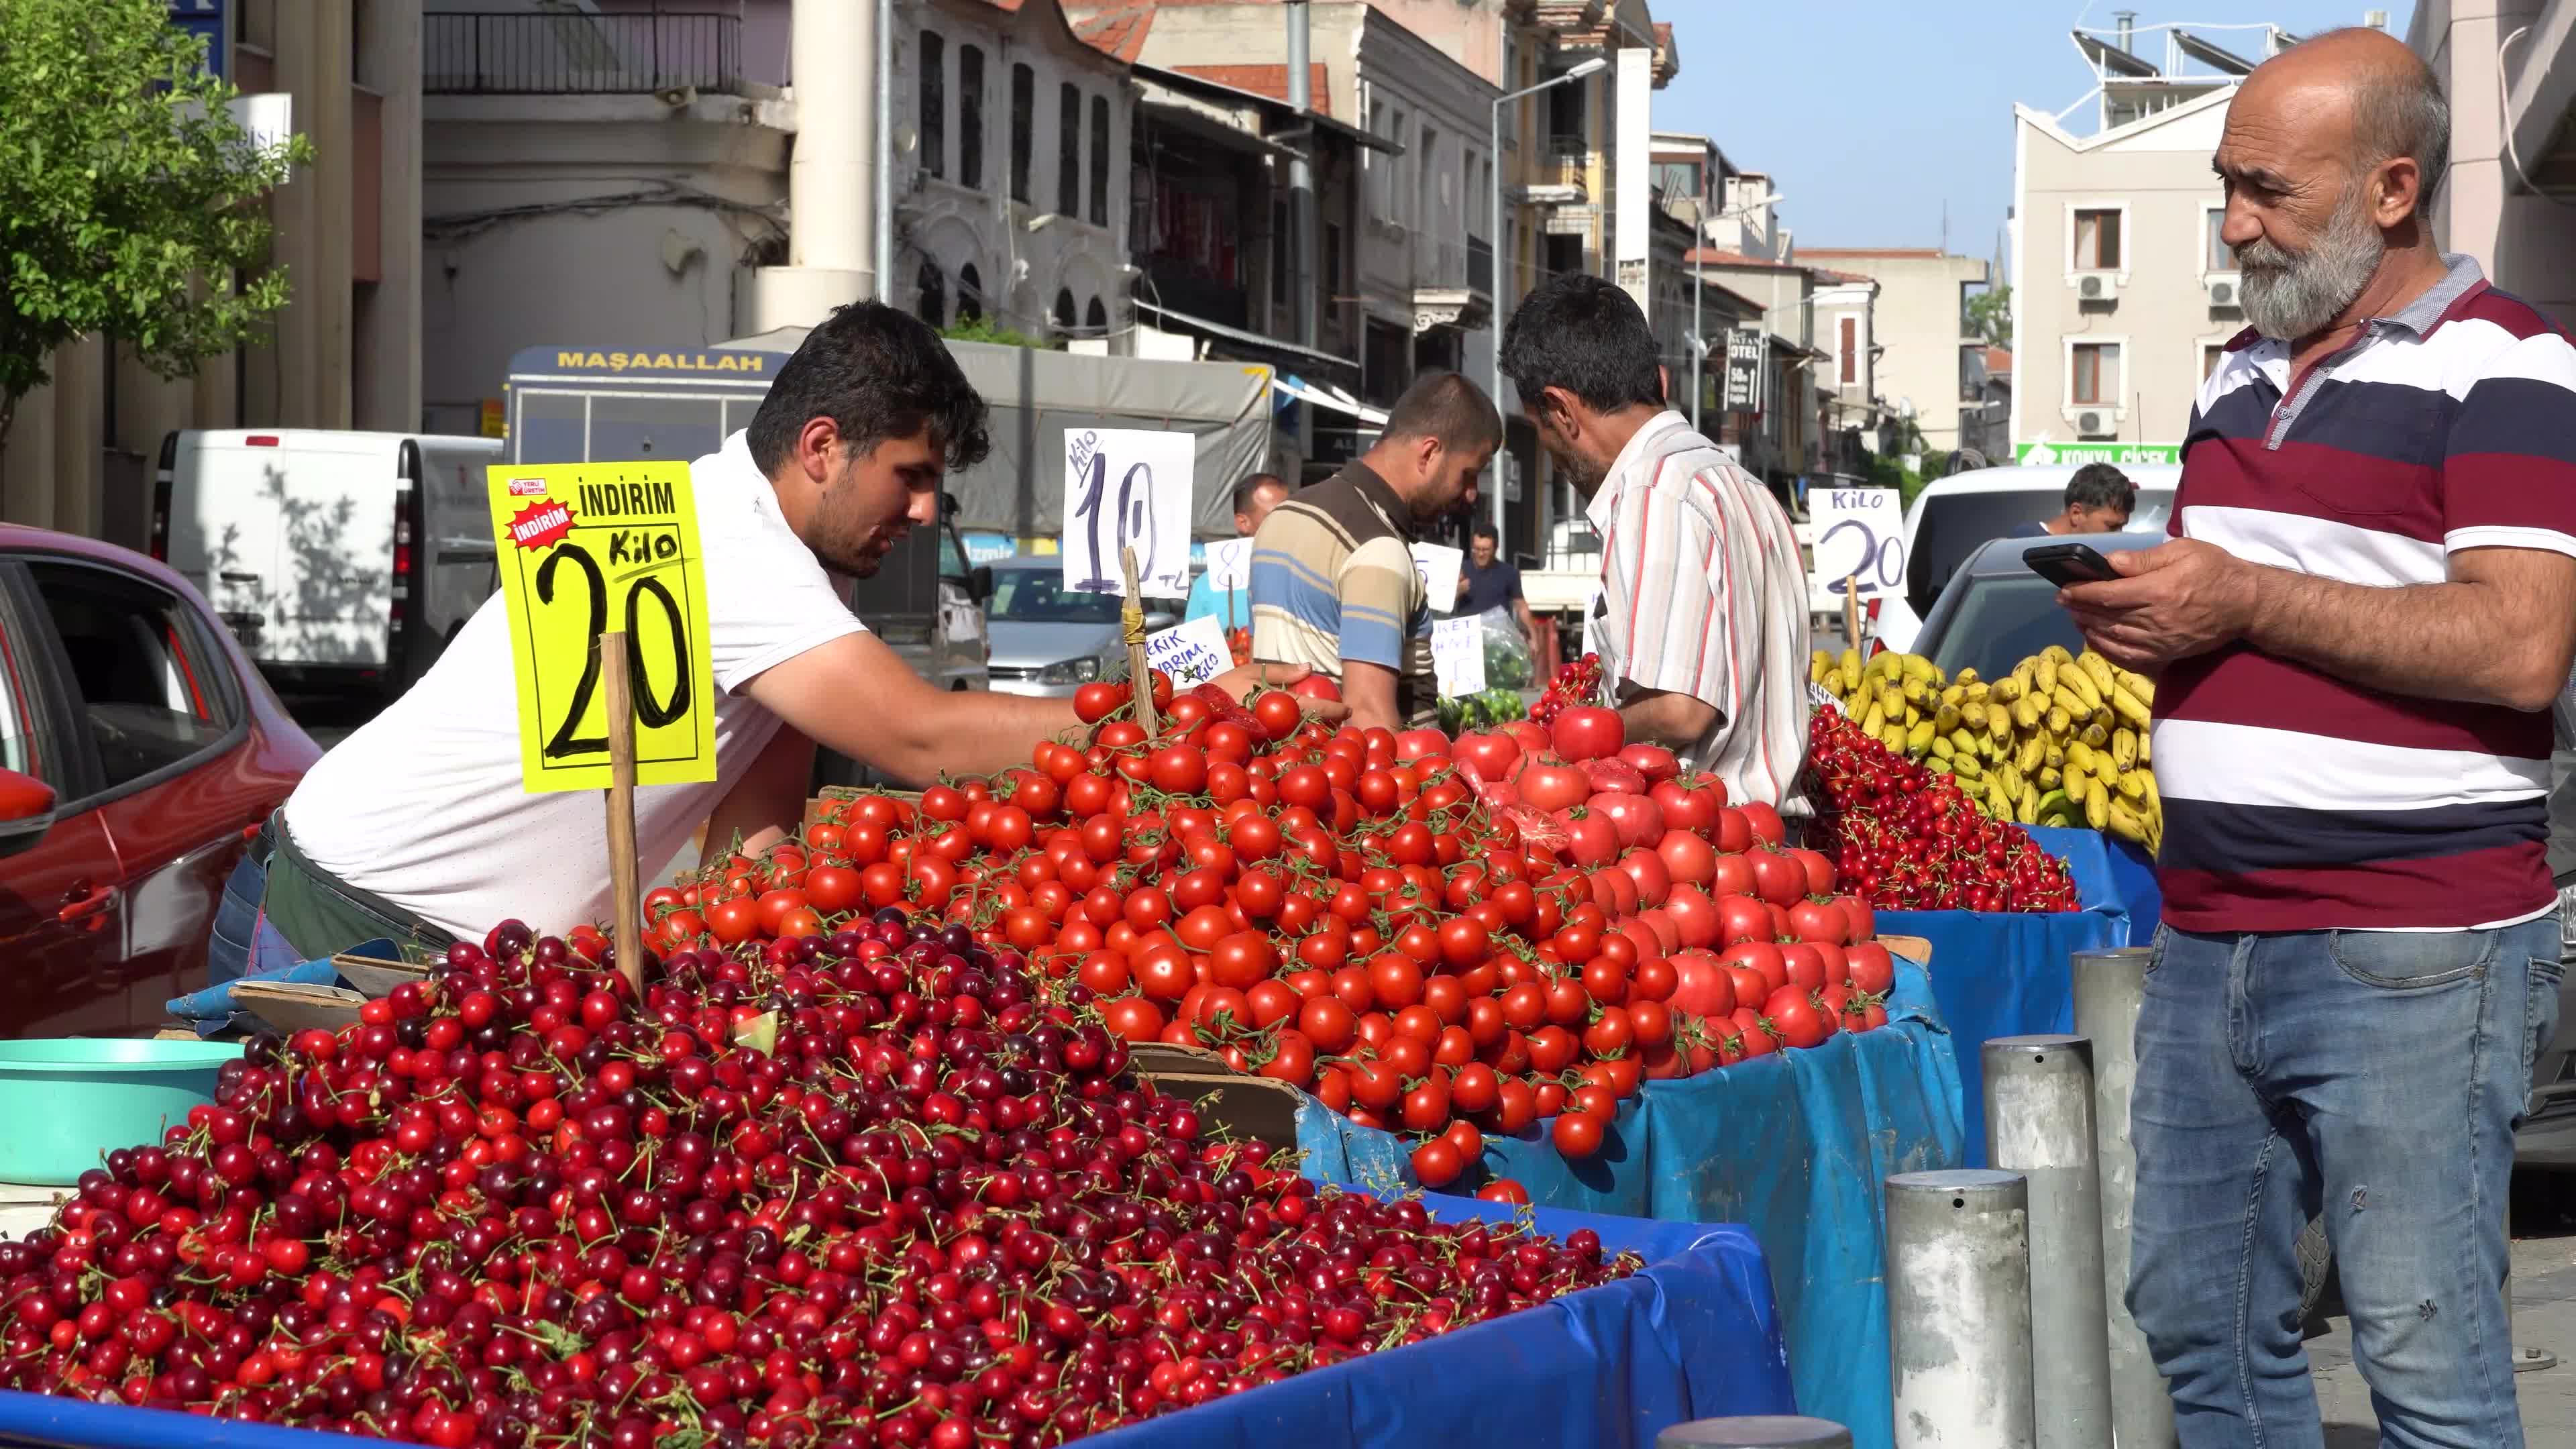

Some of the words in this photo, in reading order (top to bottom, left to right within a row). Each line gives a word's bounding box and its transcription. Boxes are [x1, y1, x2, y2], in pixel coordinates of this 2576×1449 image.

[557, 352, 763, 371] MAŞAALLAH
[1730, 345, 1758, 359] OTEL
[2061, 449, 2113, 464] KONYA
[578, 475, 676, 517] İNDİRİM
[512, 506, 570, 542] İNDİRİM
[1075, 453, 1157, 594] 10
[1217, 542, 1243, 588] 8
[1819, 519, 1904, 594] 20
[1158, 570, 1189, 591] TL
[536, 543, 691, 759] 20
